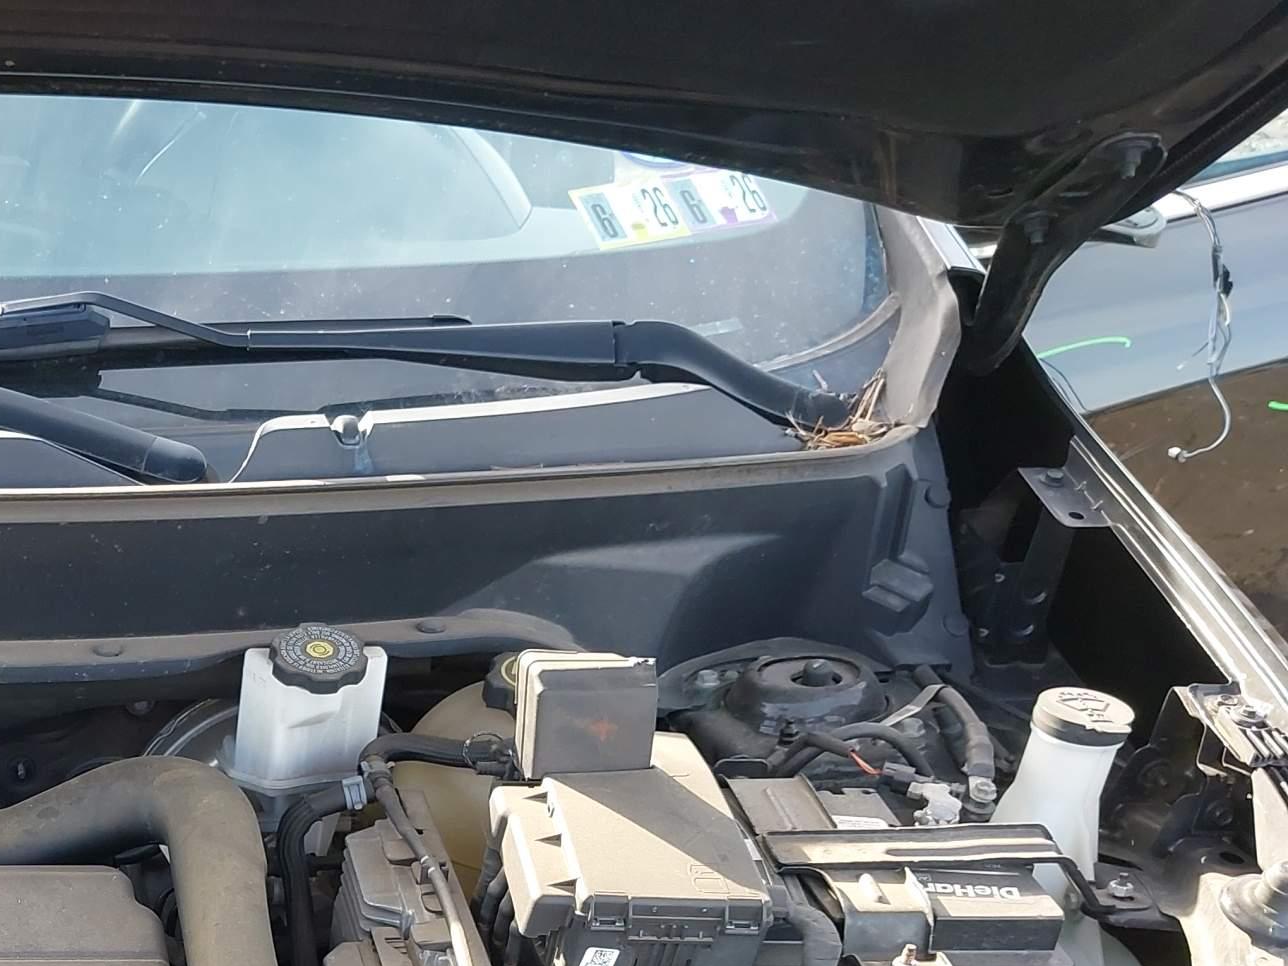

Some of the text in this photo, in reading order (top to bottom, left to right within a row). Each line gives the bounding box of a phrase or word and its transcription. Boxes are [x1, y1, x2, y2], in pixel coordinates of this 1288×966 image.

[591, 186, 680, 239] 6 26
[680, 173, 768, 224] 6 26
[921, 882, 1022, 901] DieHar
